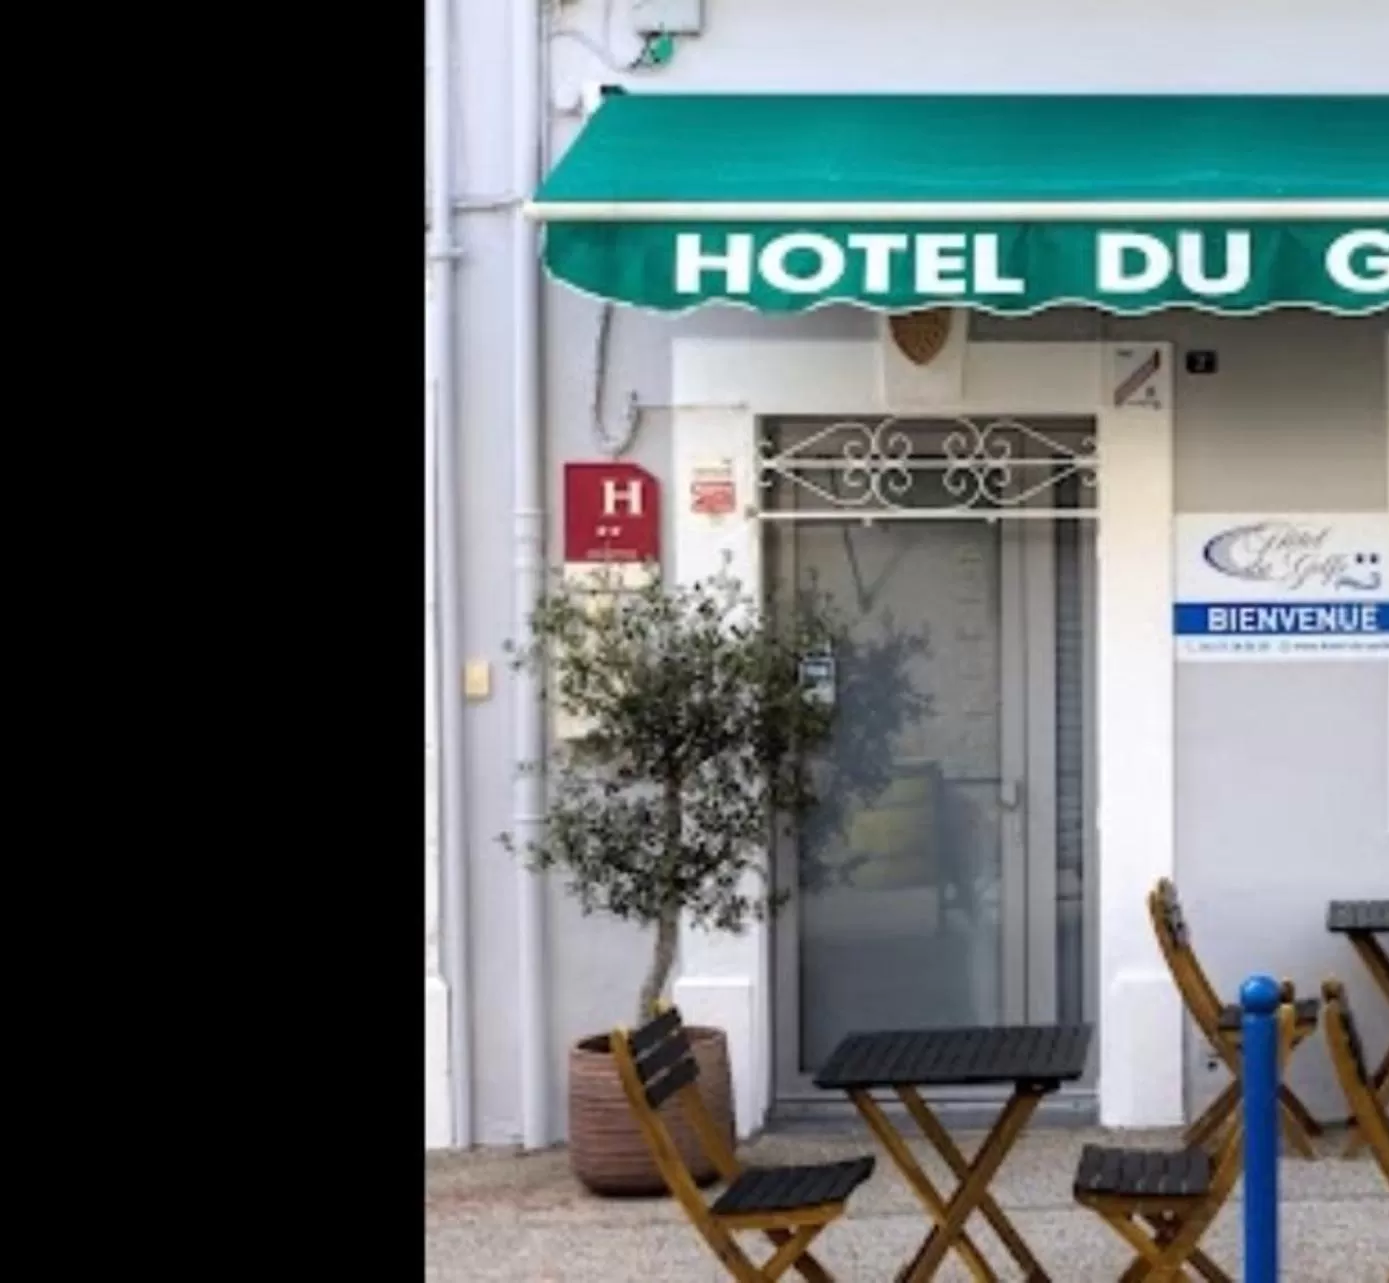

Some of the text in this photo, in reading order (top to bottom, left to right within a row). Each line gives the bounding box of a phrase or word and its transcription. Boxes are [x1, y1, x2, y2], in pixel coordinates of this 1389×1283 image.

[675, 232, 1025, 295] HOTEL
[1097, 231, 1250, 295] DU
[603, 479, 642, 516] H
[1207, 605, 1378, 632] BIENVENUE
